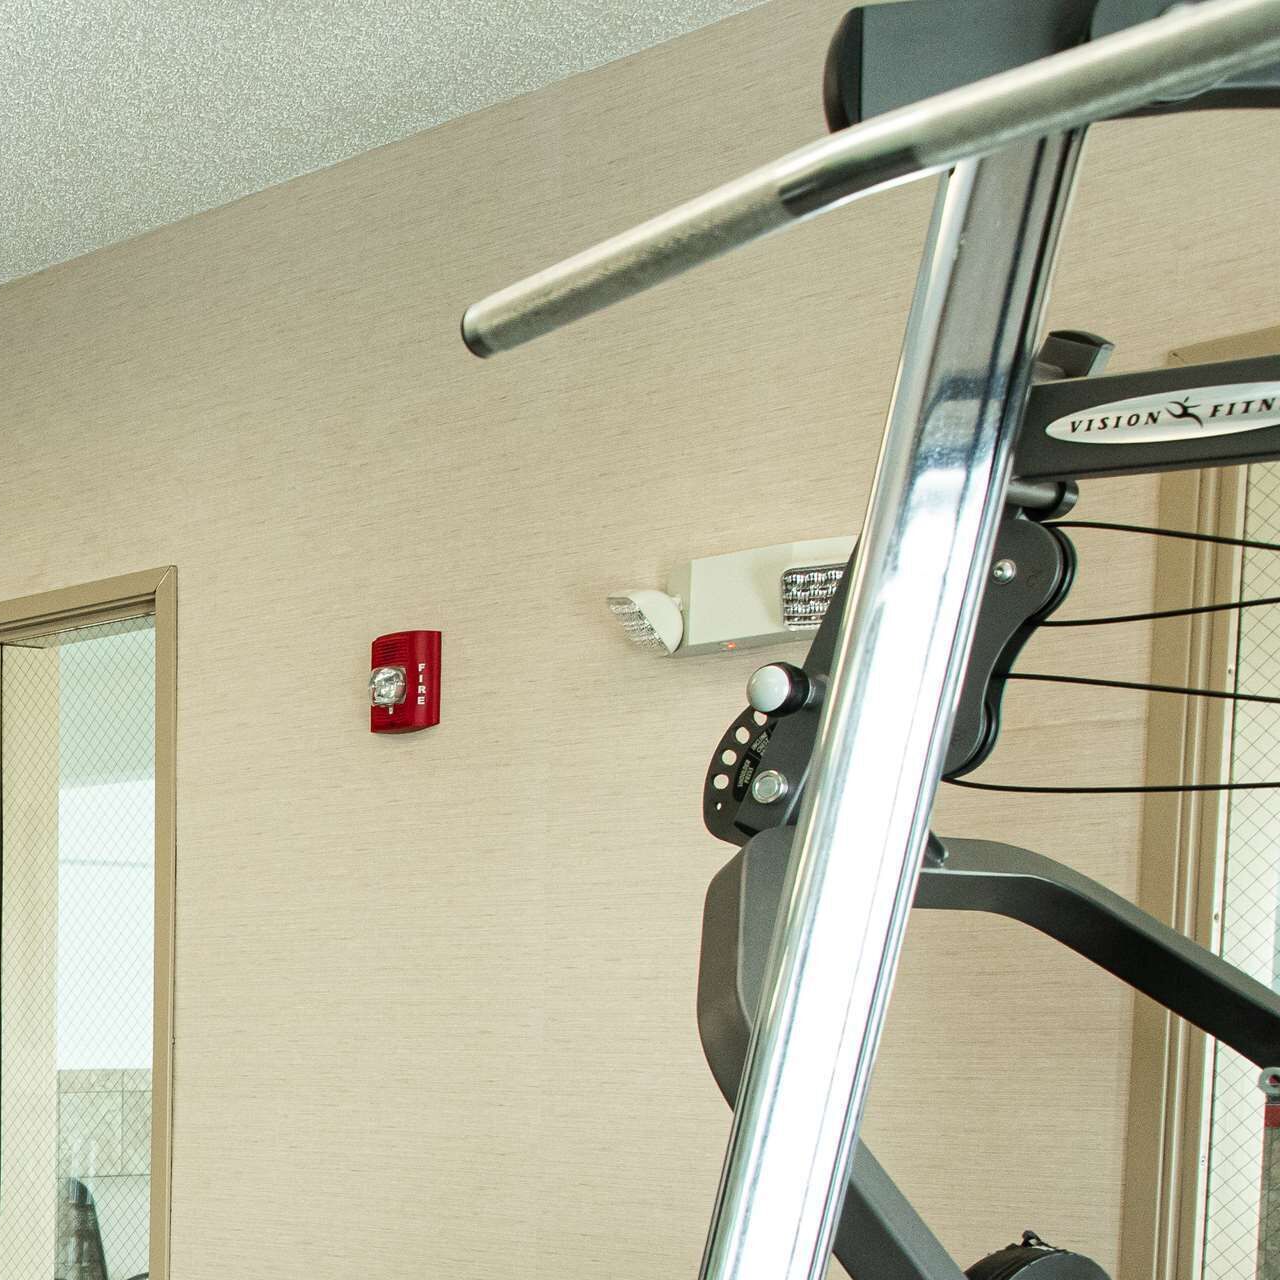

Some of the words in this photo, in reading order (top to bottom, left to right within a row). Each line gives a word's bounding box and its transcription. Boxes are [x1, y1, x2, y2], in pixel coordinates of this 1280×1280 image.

[1070, 411, 1161, 433] VISION
[1209, 397, 1279, 417] FITN
[417, 663, 427, 705] FIRE
